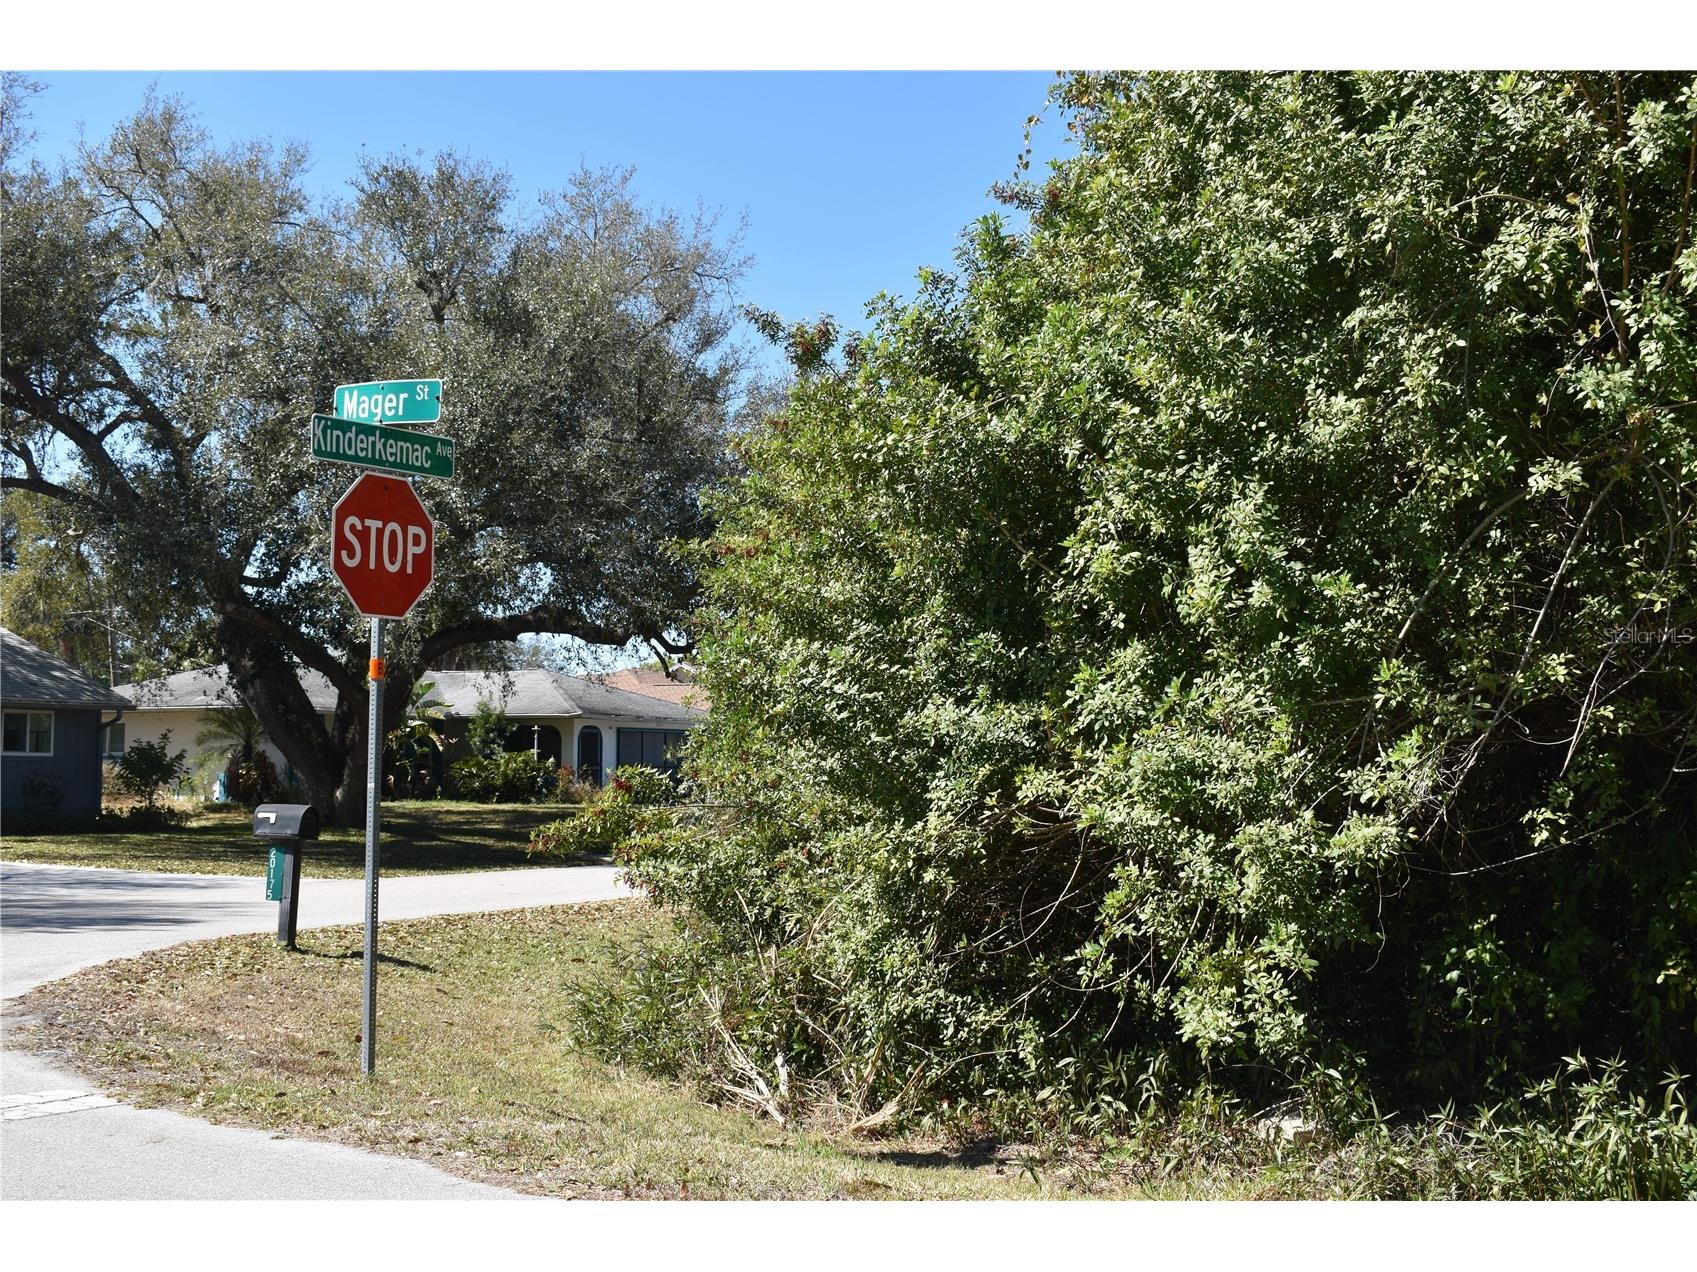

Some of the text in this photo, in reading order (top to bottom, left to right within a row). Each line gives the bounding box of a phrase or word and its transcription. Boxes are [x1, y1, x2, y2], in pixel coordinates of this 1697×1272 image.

[343, 384, 430, 421] Mager St
[313, 418, 453, 468] Kinderkemac Ave
[340, 515, 427, 575] STOP
[267, 848, 276, 899] 20175
